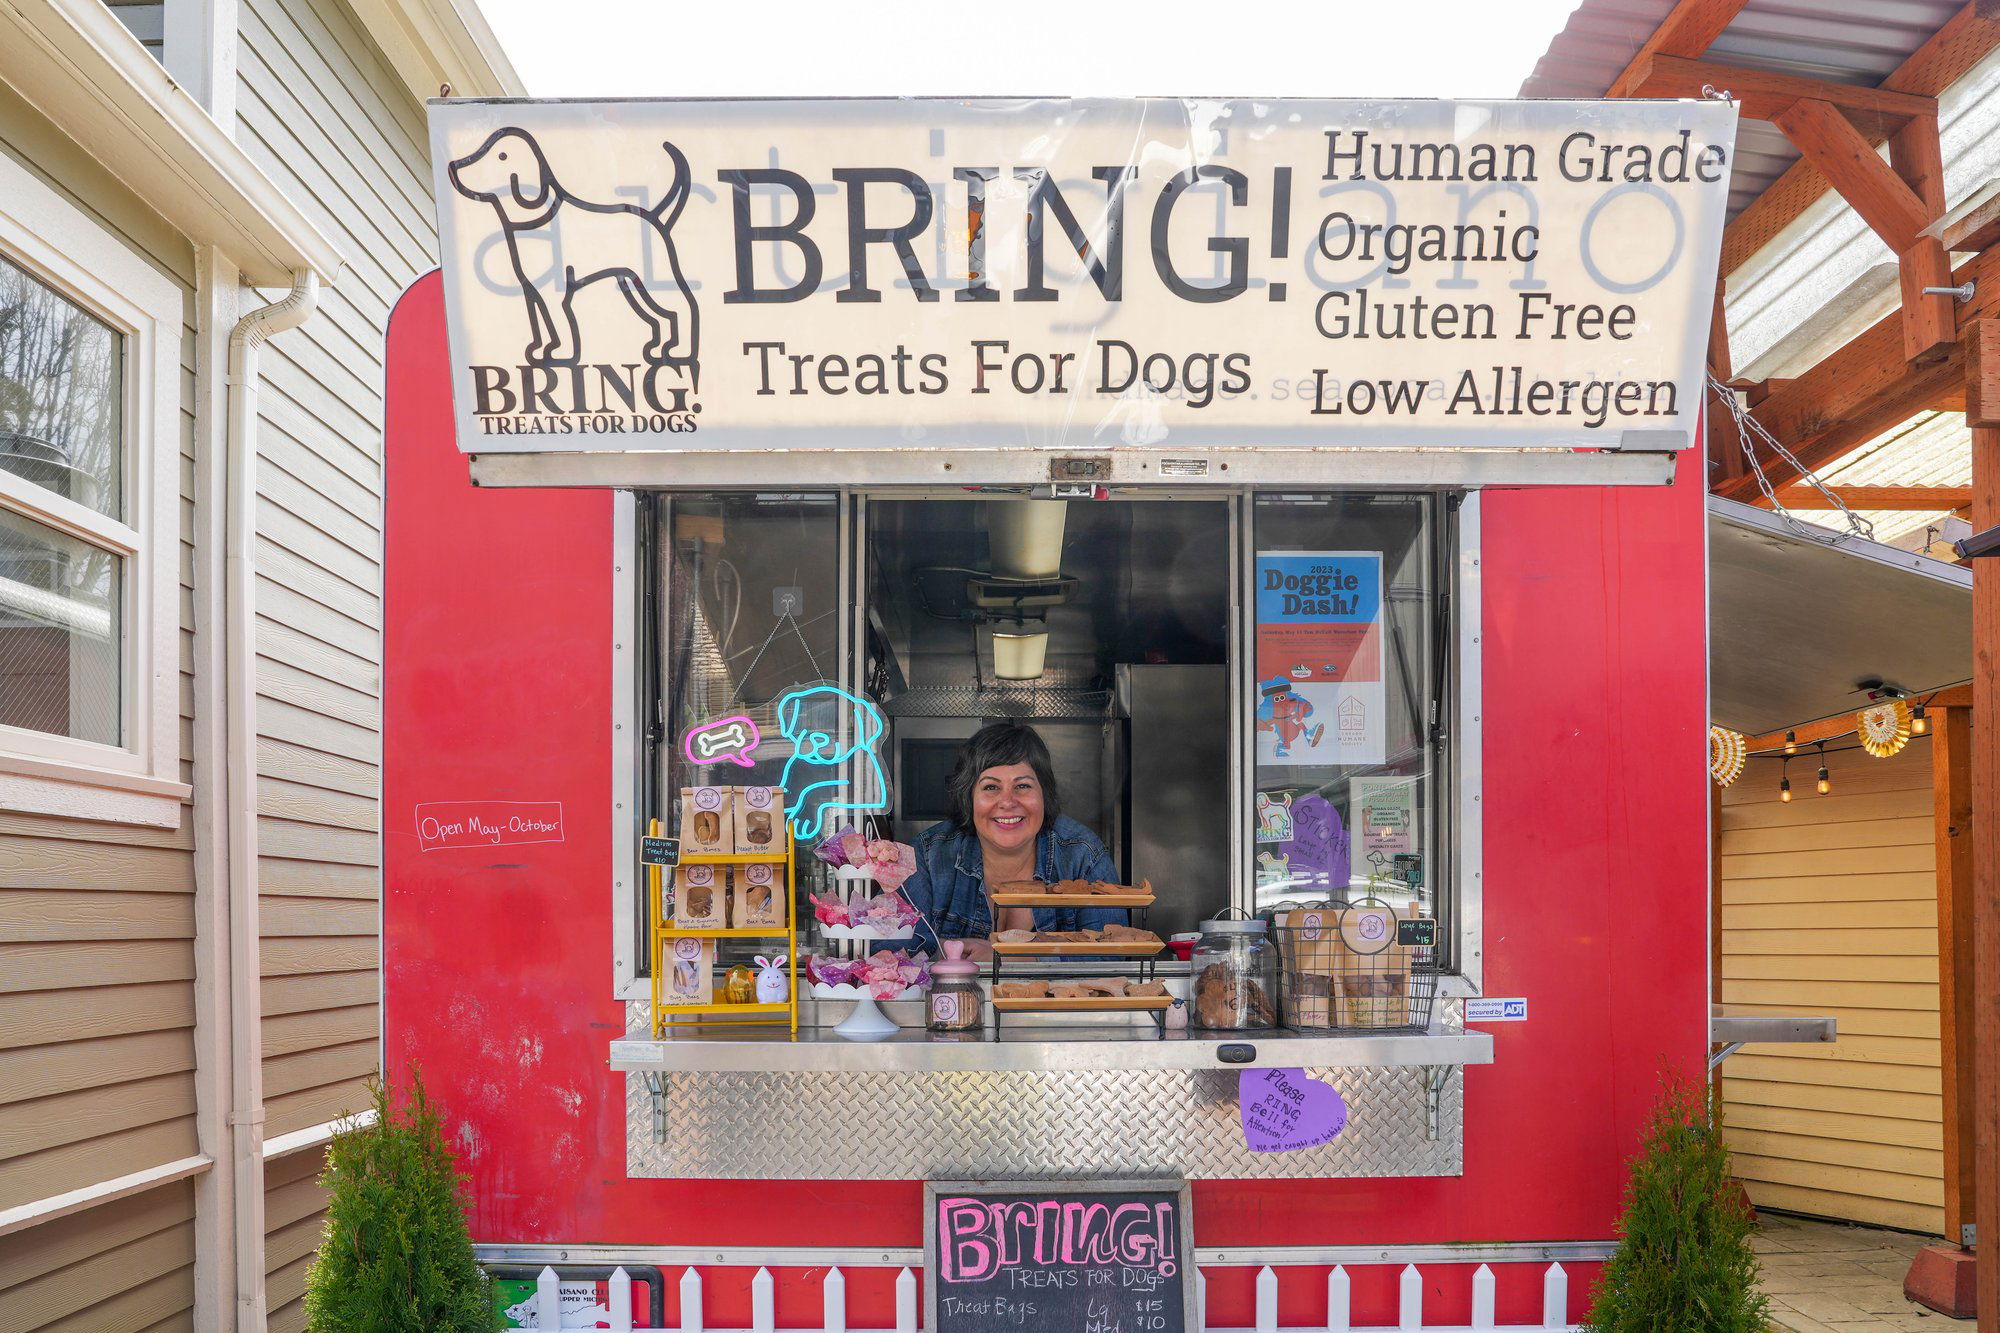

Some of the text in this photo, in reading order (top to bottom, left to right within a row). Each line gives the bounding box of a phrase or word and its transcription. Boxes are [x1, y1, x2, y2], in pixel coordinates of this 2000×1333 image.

[1322, 129, 1726, 184] Human Grade
[717, 166, 1292, 304] BRING!
[1318, 210, 1539, 275] Organic
[1315, 291, 1636, 340] Gluten Free
[743, 340, 1252, 409] Treats For Dogs
[470, 360, 702, 415] BRING!
[1310, 367, 1679, 428] Low Allergen
[480, 413, 697, 436] TREATS FOR DOGS
[1264, 568, 1359, 597] Doggie
[1310, 566, 1334, 574] 2023
[1281, 593, 1360, 616] Dash!
[421, 817, 464, 842] Open
[645, 839, 672, 847] Medium
[645, 847, 678, 859] Treat Bags
[1400, 922, 1433, 931] Large Bags
[1416, 935, 1430, 944] $15
[1504, 1003, 1524, 1016] ADT
[1264, 1068, 1305, 1106] Please
[1250, 1102, 1295, 1132] Bell for
[1264, 1094, 1301, 1122] RING
[1246, 1116, 1289, 1141] Attention!
[1256, 1143, 1267, 1152] We
[1271, 1143, 1281, 1151] get
[1284, 1140, 1308, 1150] caught
[1311, 1138, 1320, 1146] up
[1002, 1267, 1079, 1291] TREATS
[1085, 1269, 1116, 1287] FOR
[559, 1288, 588, 1296] AISANO
[942, 1297, 994, 1317] Treat
[995, 1297, 1038, 1324] Bags
[1135, 1299, 1163, 1313] $15
[1137, 1315, 1166, 1330] $10
